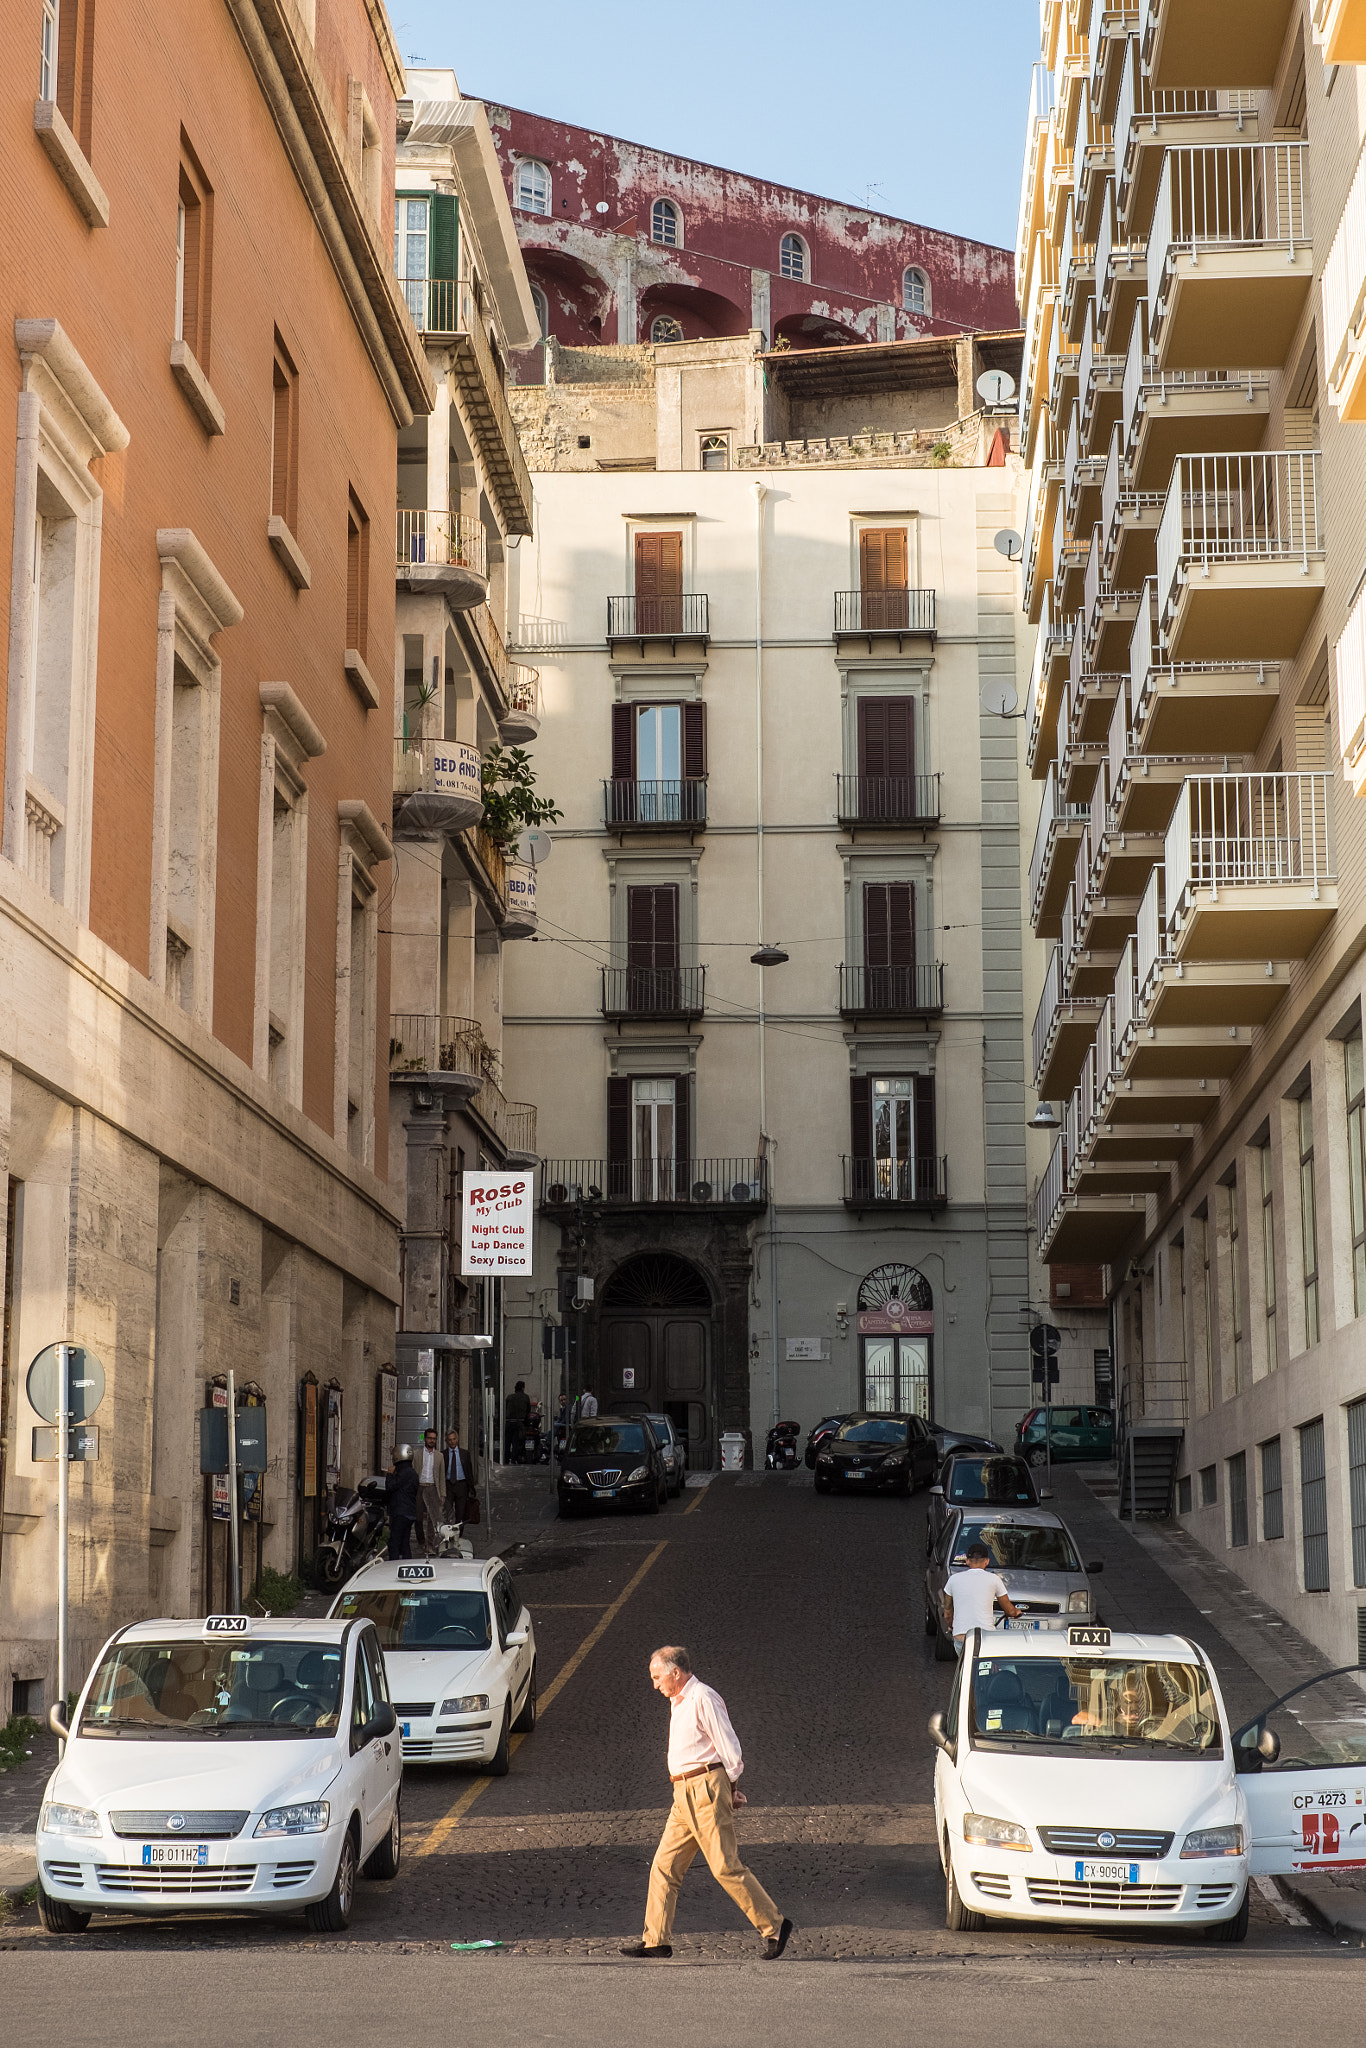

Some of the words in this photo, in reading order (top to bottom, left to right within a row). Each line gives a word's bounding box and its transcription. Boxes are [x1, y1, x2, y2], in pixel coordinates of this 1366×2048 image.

[434, 757, 456, 773] BED
[459, 762, 476, 778] AND
[446, 780, 459, 788] 081
[510, 880, 526, 893] BED
[470, 1181, 526, 1206] Rose
[476, 1206, 492, 1217] My
[495, 1197, 523, 1211] Club
[472, 1224, 499, 1236] Night
[502, 1225, 525, 1234] Club
[471, 1240, 490, 1251] Lap
[493, 1240, 525, 1250] Dance
[470, 1255, 494, 1267] Sexy
[497, 1255, 526, 1265] Disco
[401, 1567, 430, 1577] TAXI
[209, 1618, 245, 1630] TAXI
[1072, 1631, 1107, 1643] TAXI
[1293, 1795, 1314, 1809] CP
[1317, 1793, 1347, 1806] 4273
[152, 1848, 164, 1861] DB
[167, 1848, 198, 1861] 011HZ
